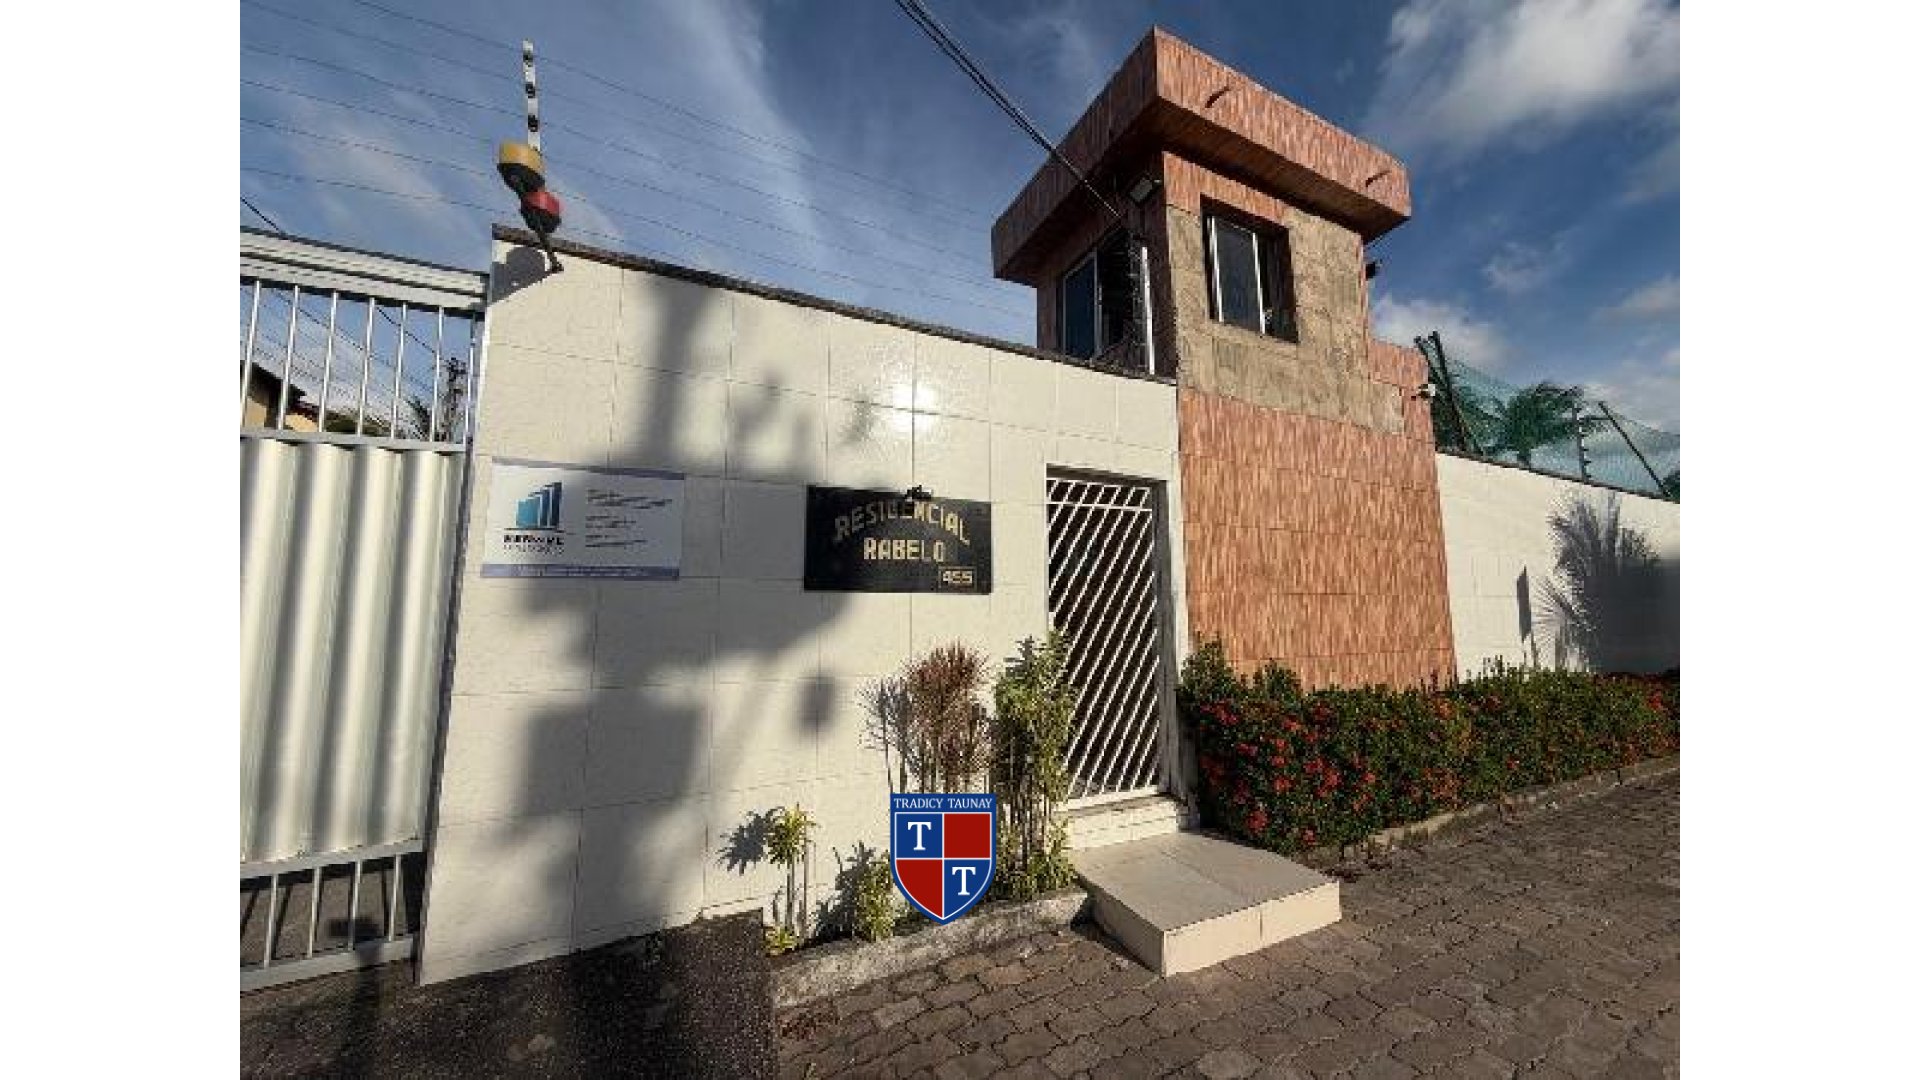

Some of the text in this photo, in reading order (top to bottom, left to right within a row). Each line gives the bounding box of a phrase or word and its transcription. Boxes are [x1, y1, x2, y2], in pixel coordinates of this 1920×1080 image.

[833, 501, 970, 546] RESIDENCIAL
[863, 537, 946, 563] RABELO
[942, 570, 973, 584] 455
